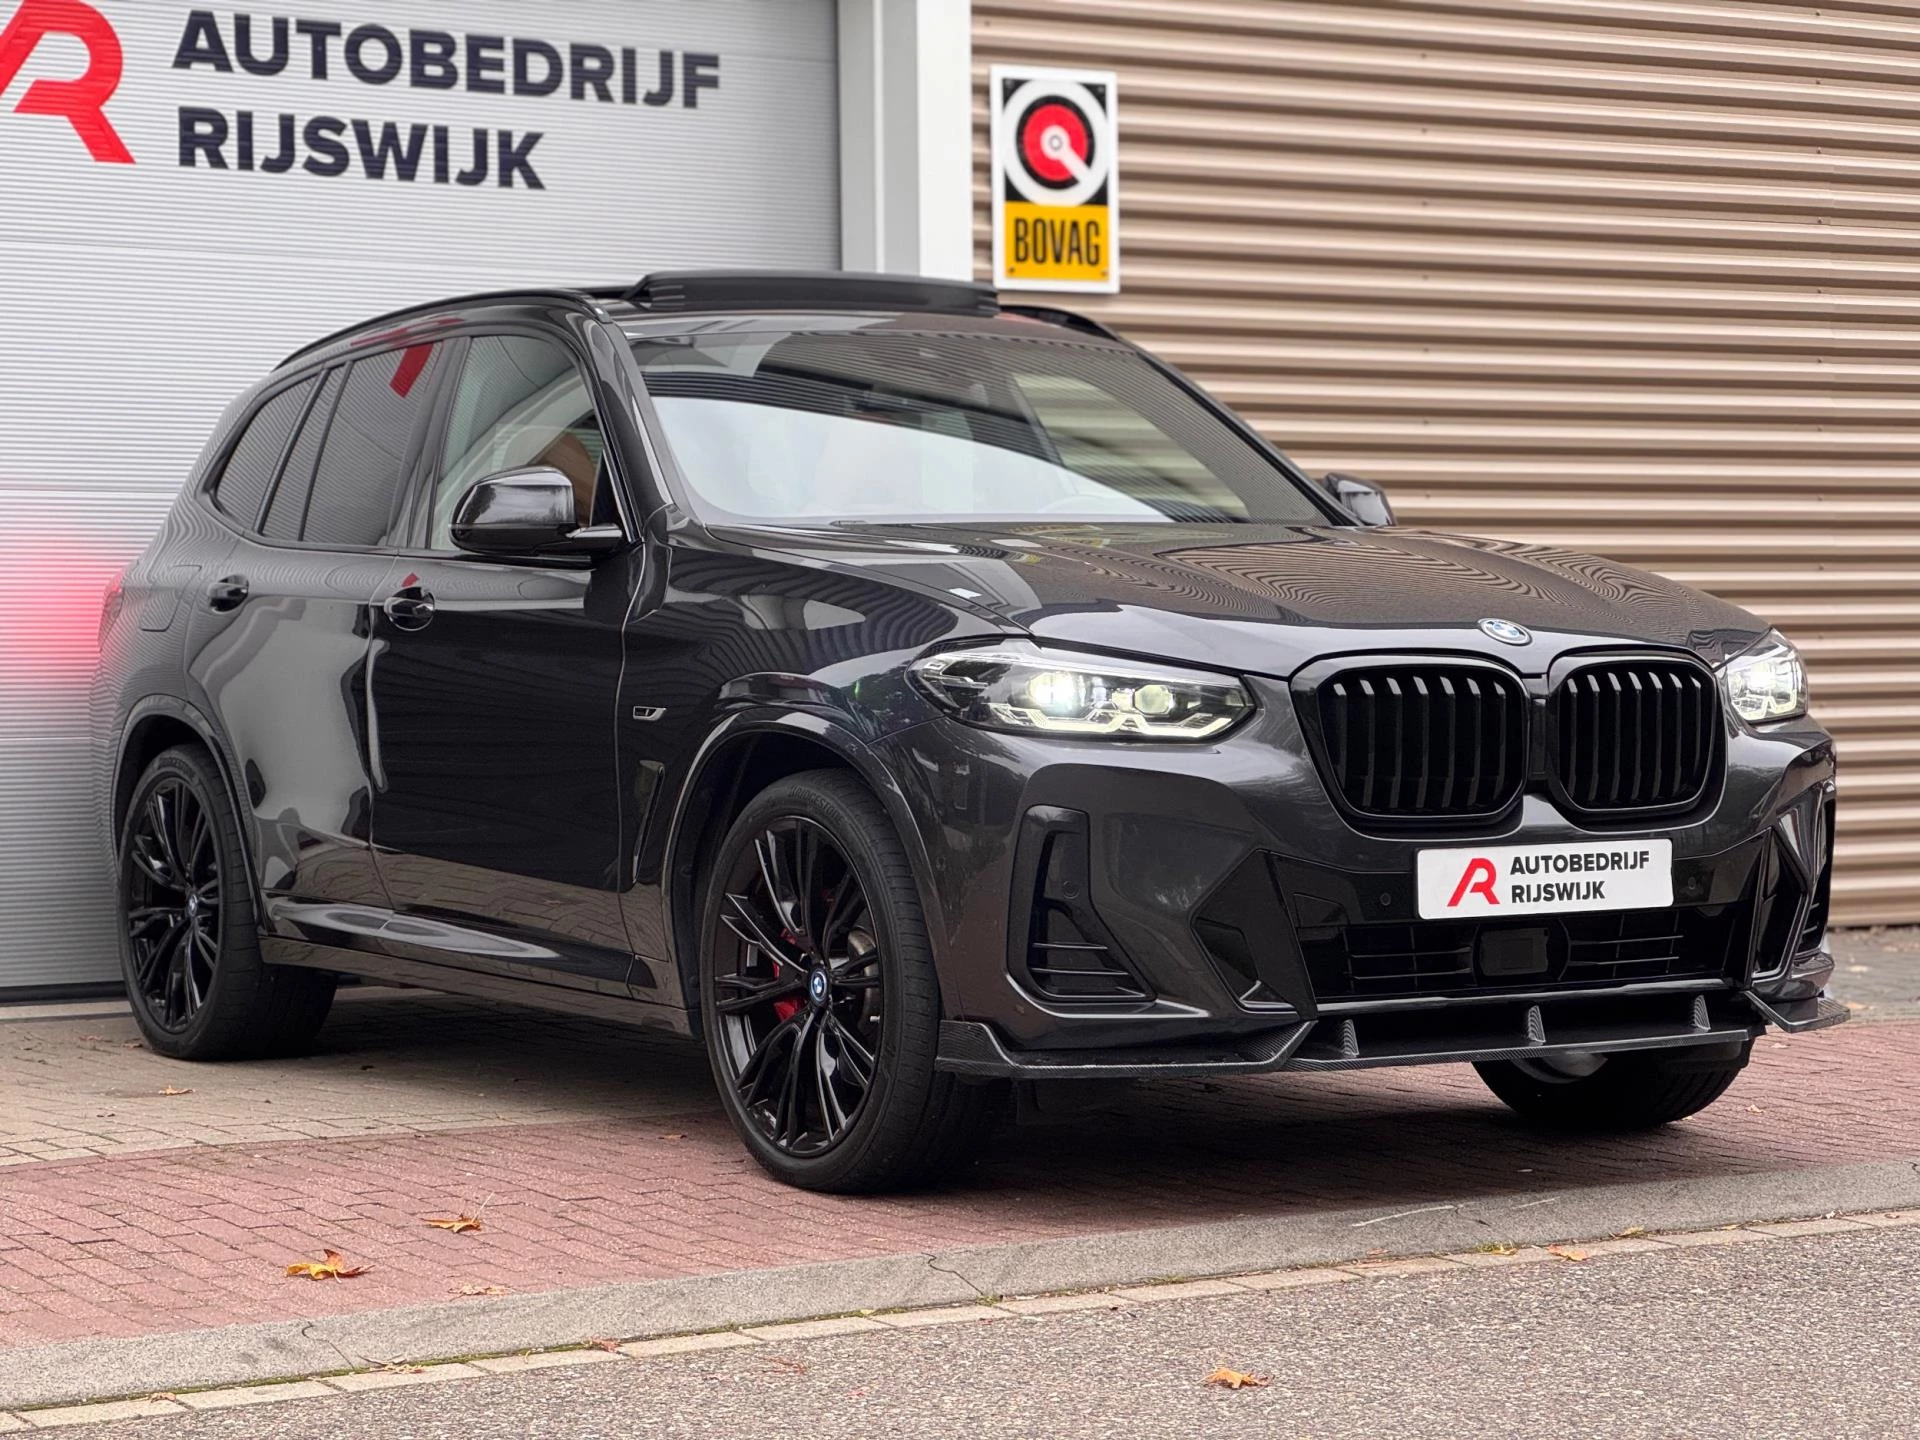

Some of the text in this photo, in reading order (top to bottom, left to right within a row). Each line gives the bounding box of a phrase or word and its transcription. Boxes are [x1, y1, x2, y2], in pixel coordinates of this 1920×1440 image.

[172, 10, 720, 110] AUTOBEDRIJF
[178, 106, 546, 190] RIJSWIJK
[1014, 217, 1101, 267] BOVAG
[1509, 850, 1651, 876] AUTOBEDRIJF
[1511, 880, 1606, 904] RIJSWIJK
